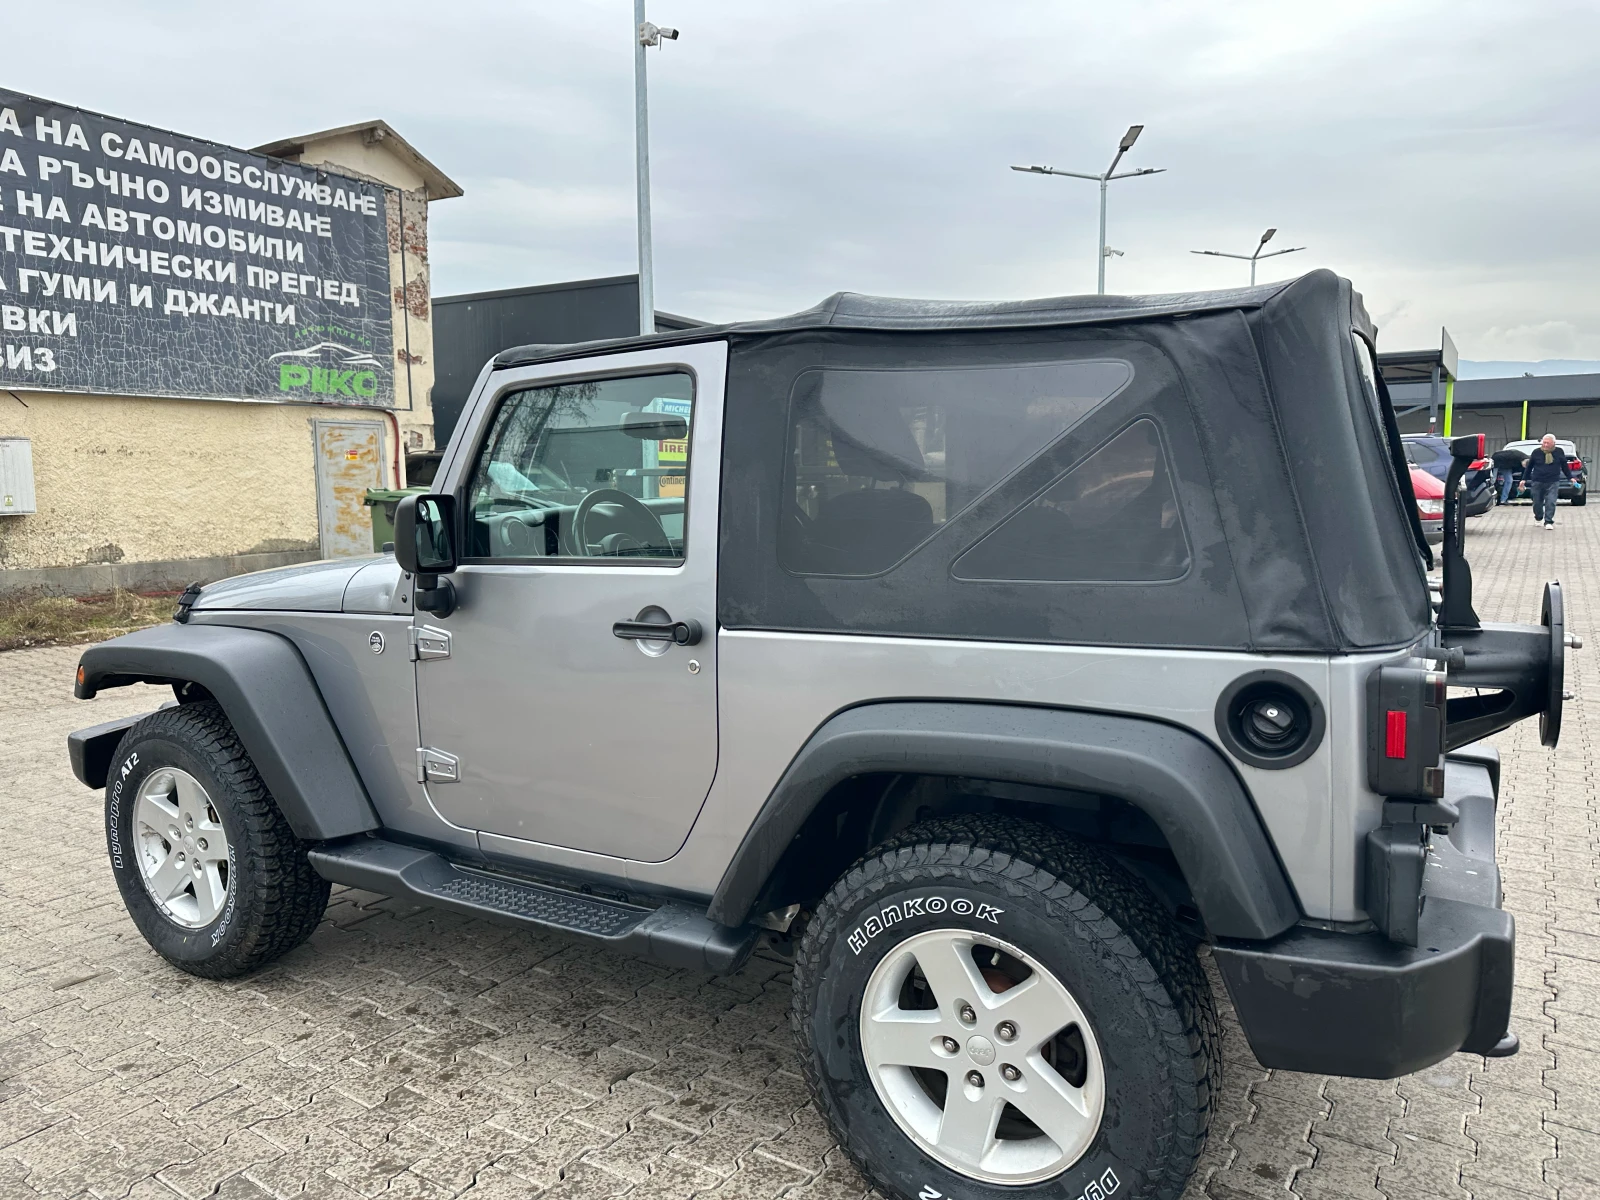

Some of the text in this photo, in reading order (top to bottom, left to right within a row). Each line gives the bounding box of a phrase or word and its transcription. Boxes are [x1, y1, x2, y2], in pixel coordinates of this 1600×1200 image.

[0, 108, 377, 216] А НА САМООБСЛУЖВАНЕ
[0, 148, 27, 177] А
[38, 155, 170, 203] РЪЧНО
[180, 185, 332, 237] ИЗМИВАНЕ
[0, 225, 237, 285] ТЕХНИЧЕСКИ
[16, 190, 71, 223] НА
[81, 203, 304, 263] АВТОМОБИЛИ
[2, 305, 77, 337] ВКИ
[18, 268, 117, 304] ГУМИ
[130, 283, 153, 309] И
[164, 288, 296, 326] ДЖАНТИ
[0, 344, 56, 372] ИЗ
[120, 752, 140, 781] AT2
